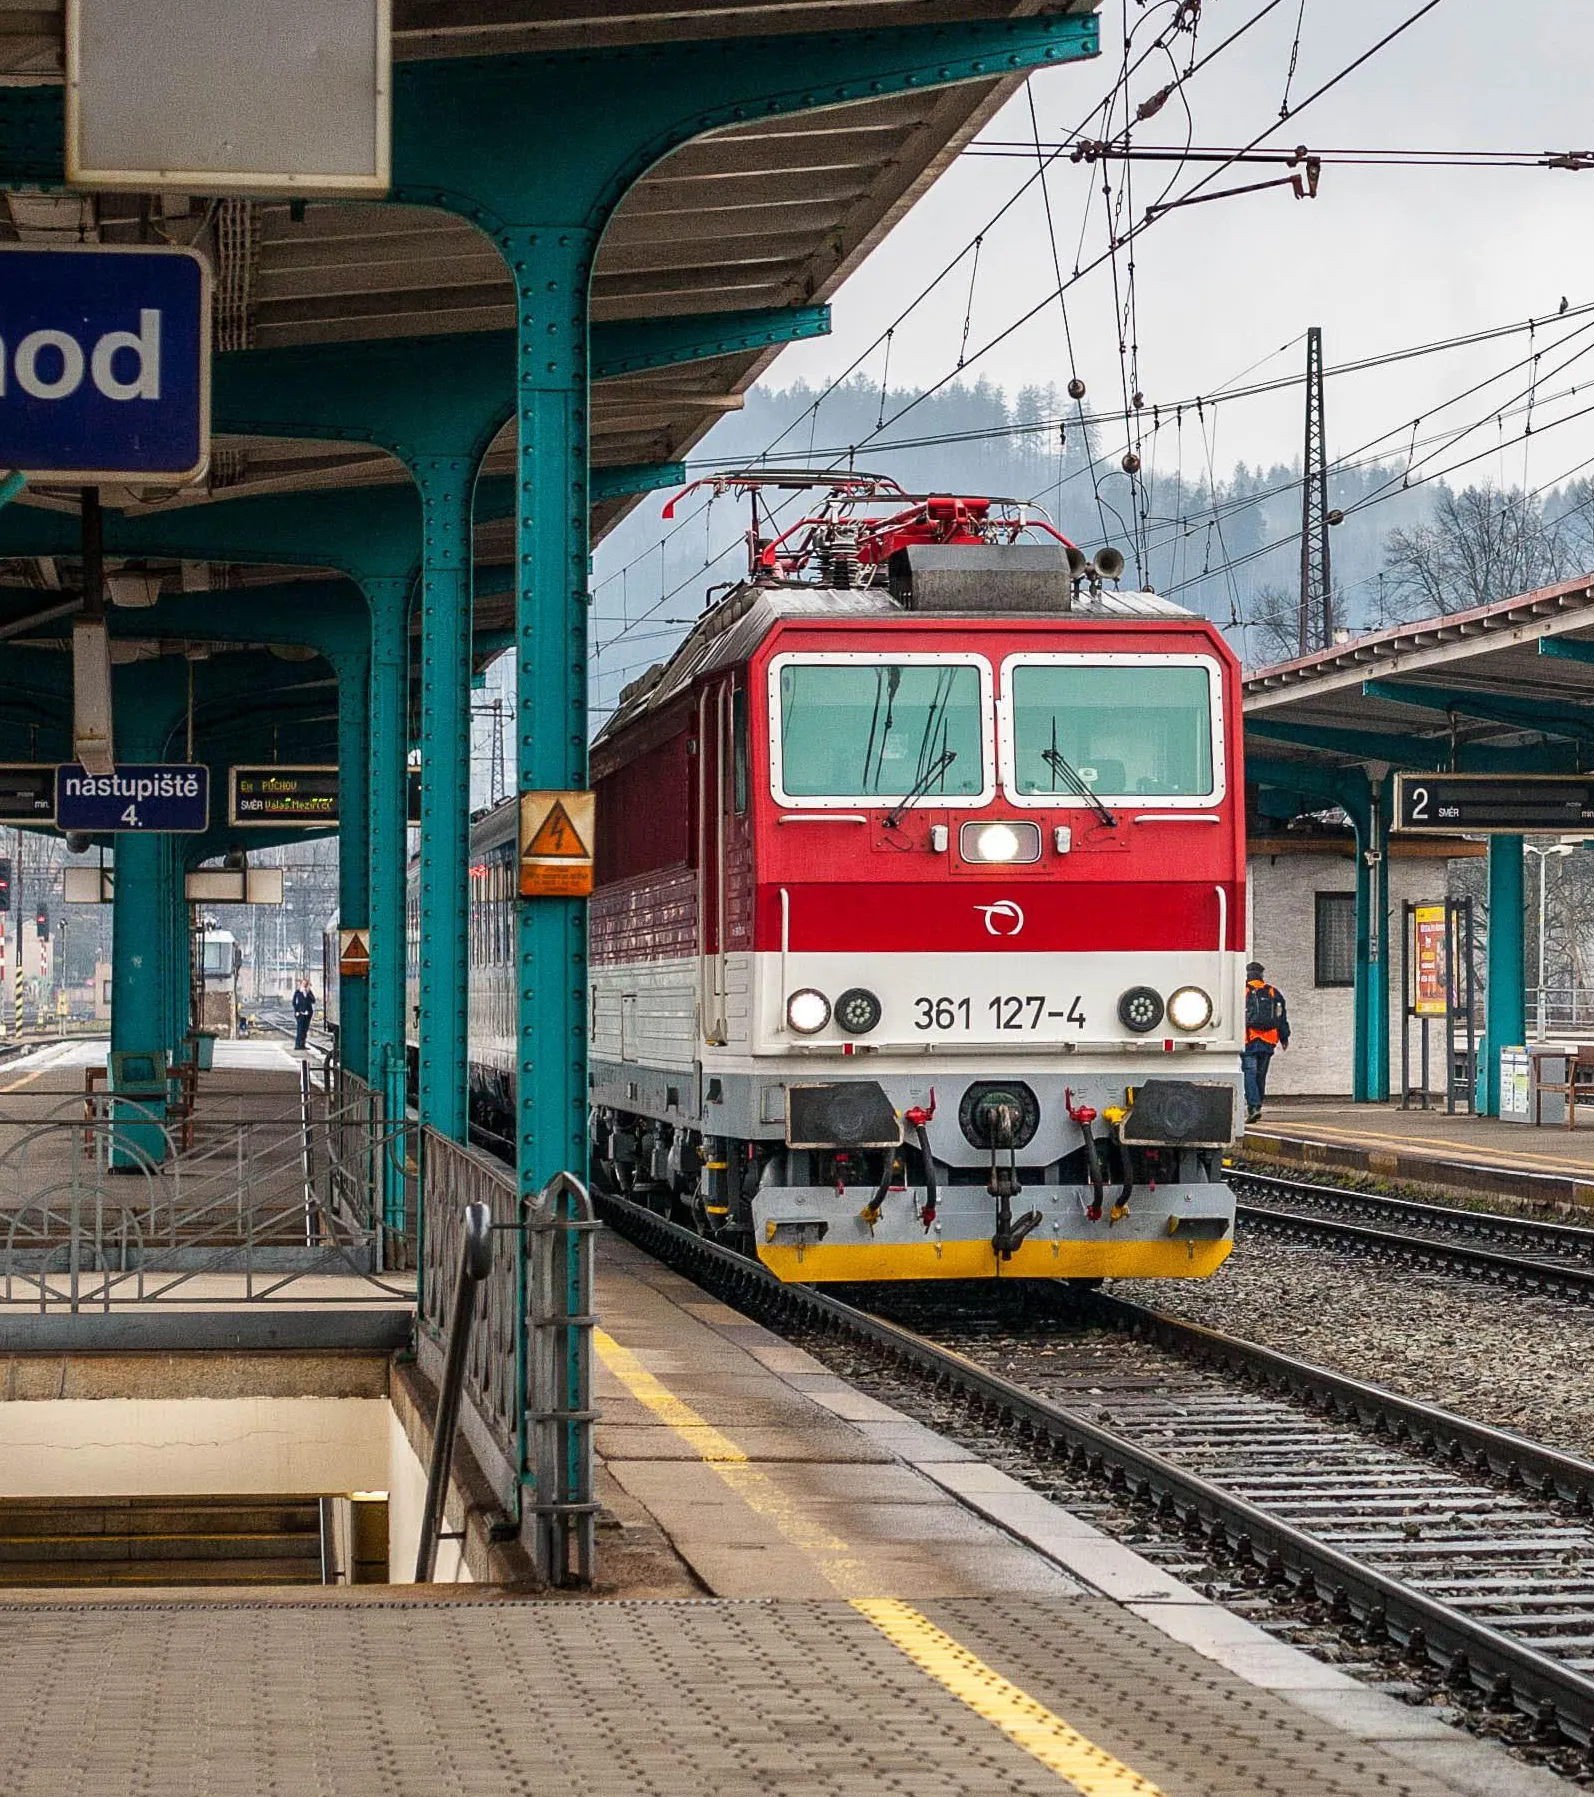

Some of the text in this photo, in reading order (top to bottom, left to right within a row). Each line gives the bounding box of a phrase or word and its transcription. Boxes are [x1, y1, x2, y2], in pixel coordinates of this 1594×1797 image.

[0, 308, 162, 400] od
[66, 773, 199, 802] nástupiště
[121, 804, 143, 826] 4.
[1412, 788, 1429, 820] 2
[914, 996, 1087, 1030] 361 127-4
